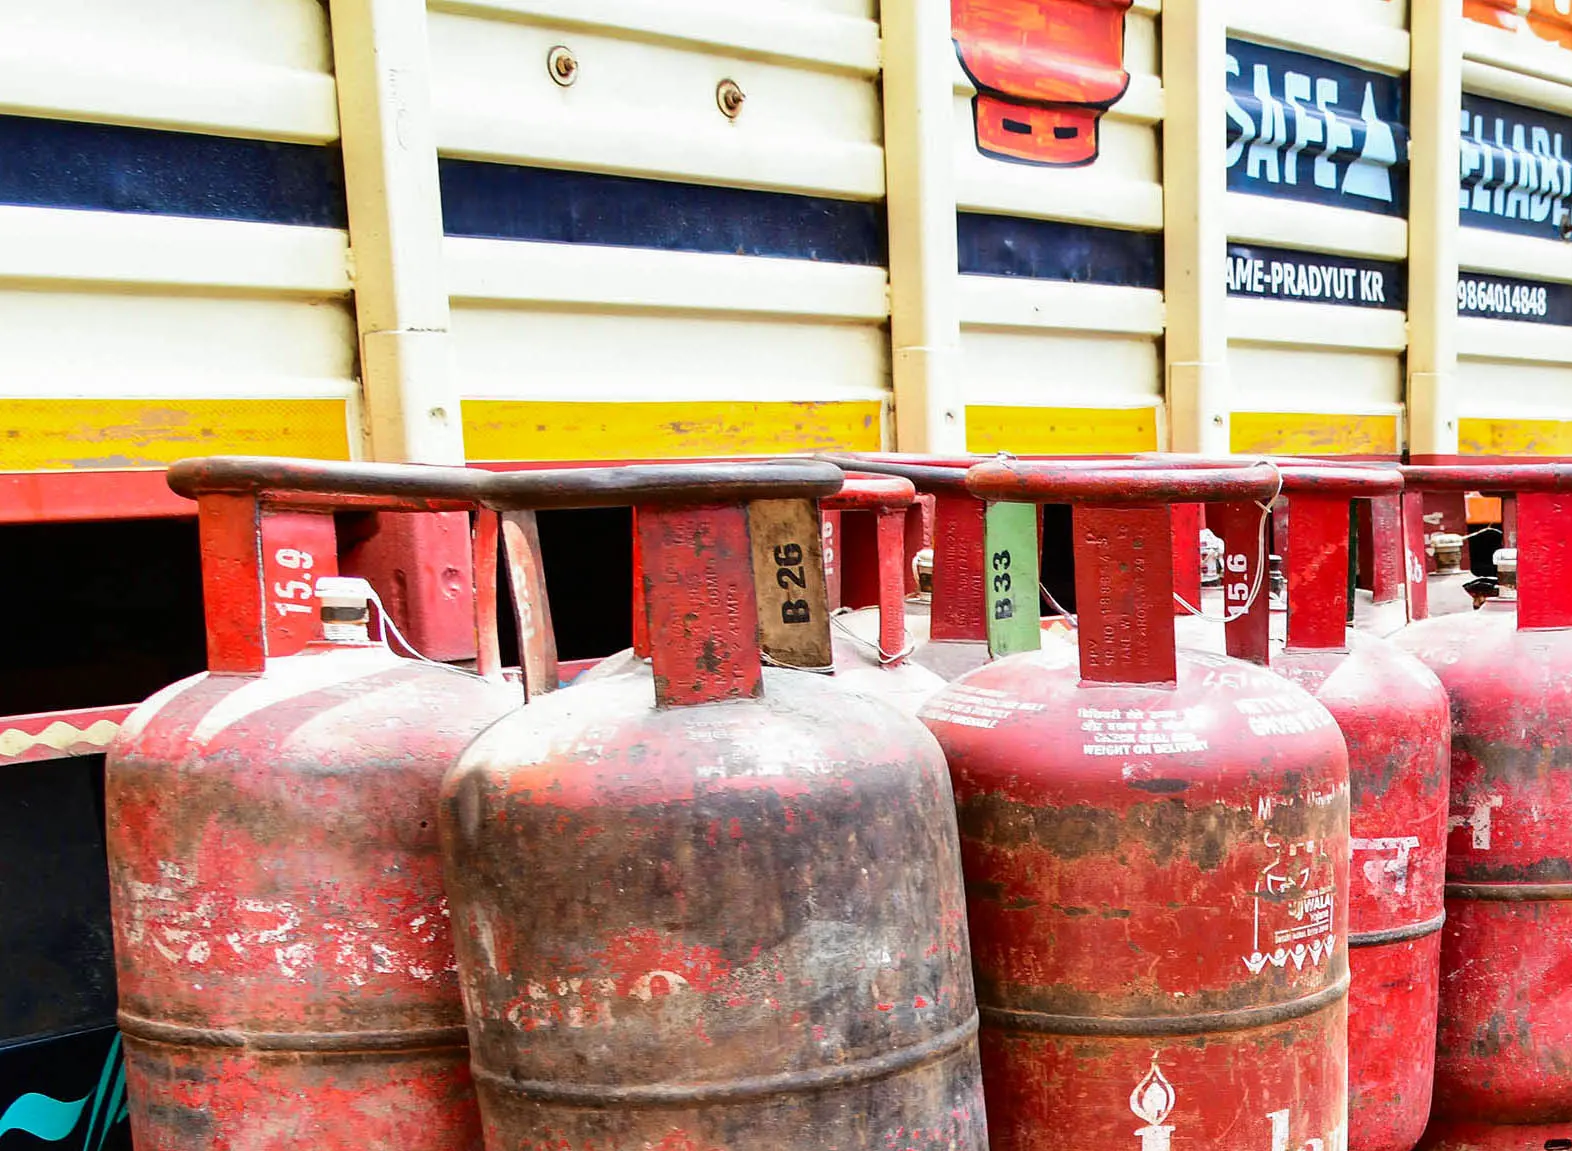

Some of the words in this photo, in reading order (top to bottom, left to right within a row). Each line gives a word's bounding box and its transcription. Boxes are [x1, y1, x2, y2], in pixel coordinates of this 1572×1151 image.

[1226, 53, 1354, 189] SAFE
[1225, 256, 1357, 300] AME-PRADYUT
[1360, 270, 1386, 302] KR
[1458, 280, 1547, 316] 9864014848
[273, 548, 314, 617] 15.9
[774, 542, 808, 591] 26
[991, 549, 1013, 594] 33
[1226, 553, 1250, 617] 15.6
[781, 599, 811, 625] B
[993, 597, 1014, 621] B
[1083, 744, 1131, 756] WEIGHT
[1153, 740, 1209, 754] DELIVERY
